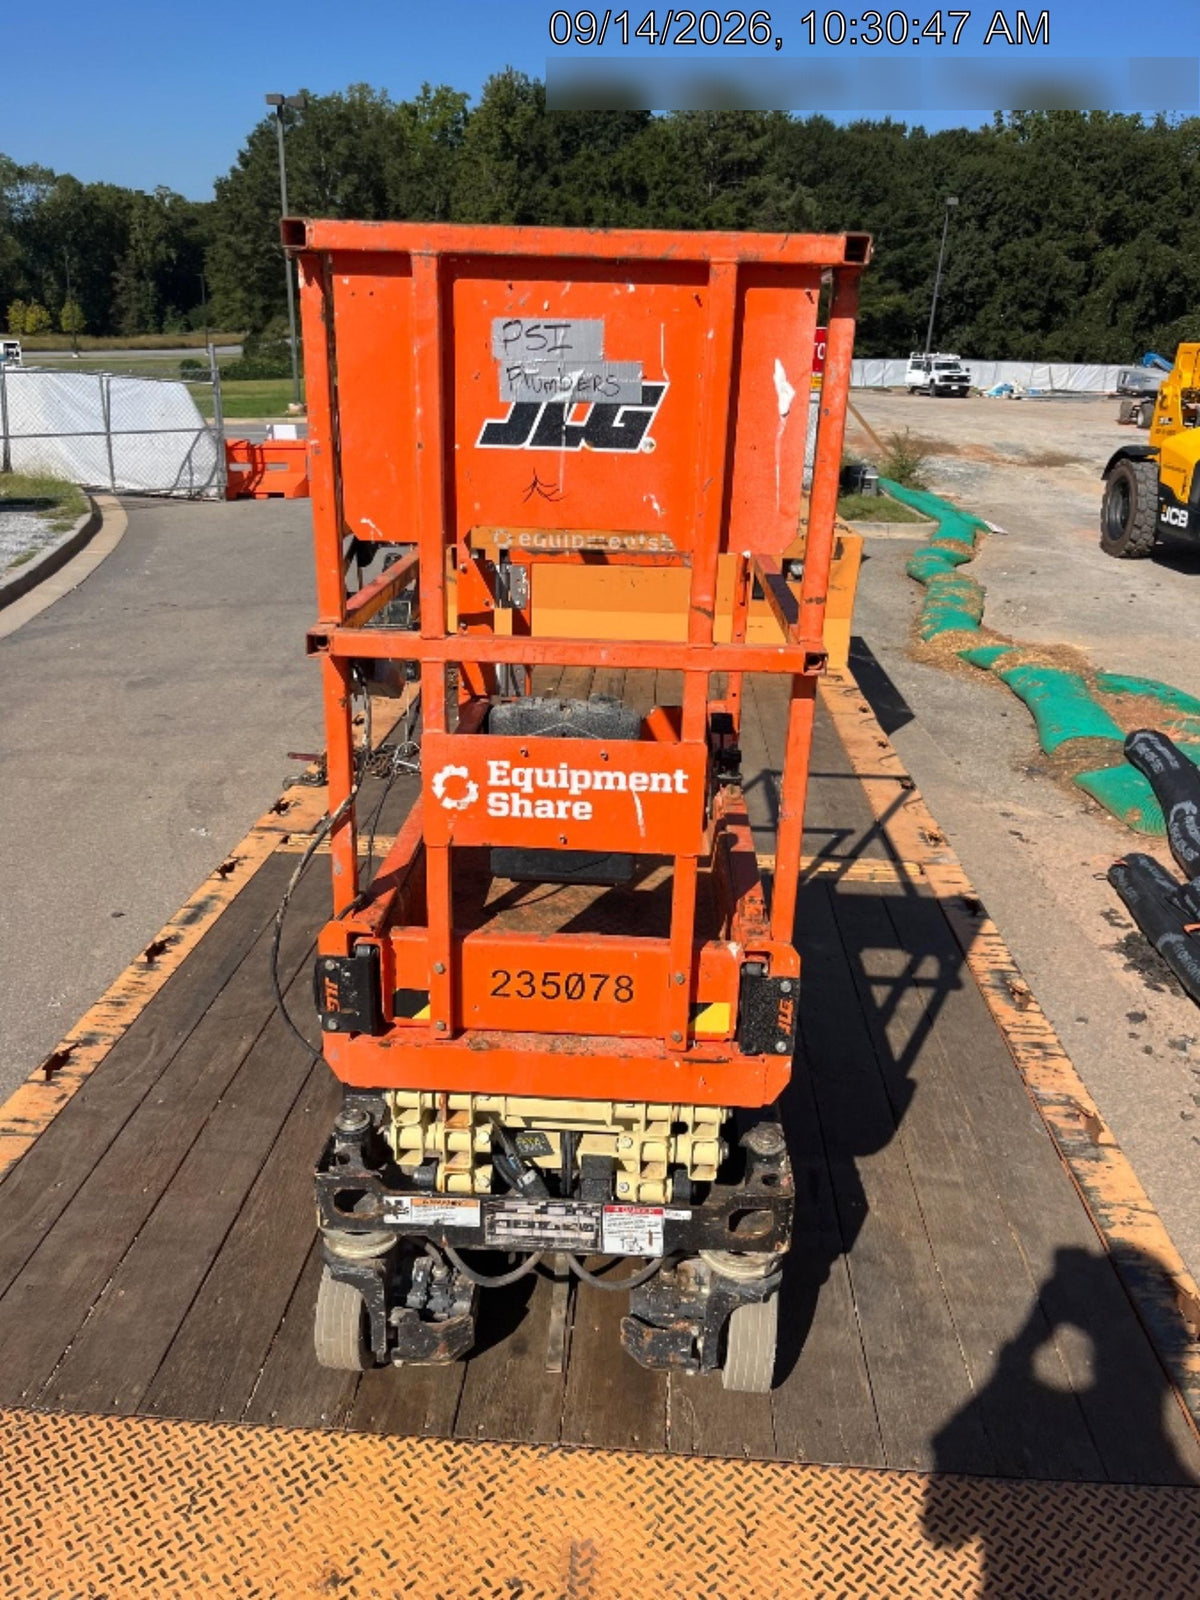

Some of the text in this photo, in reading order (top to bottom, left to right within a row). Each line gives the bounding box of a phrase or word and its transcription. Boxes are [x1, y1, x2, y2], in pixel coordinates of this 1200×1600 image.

[503, 319, 573, 356] PSI
[1161, 506, 1188, 527] JCB
[487, 760, 689, 795] Equipment
[487, 792, 593, 820] Share
[324, 976, 340, 1013] JLG
[490, 969, 634, 1003] 235078
[778, 998, 794, 1036] JLG
